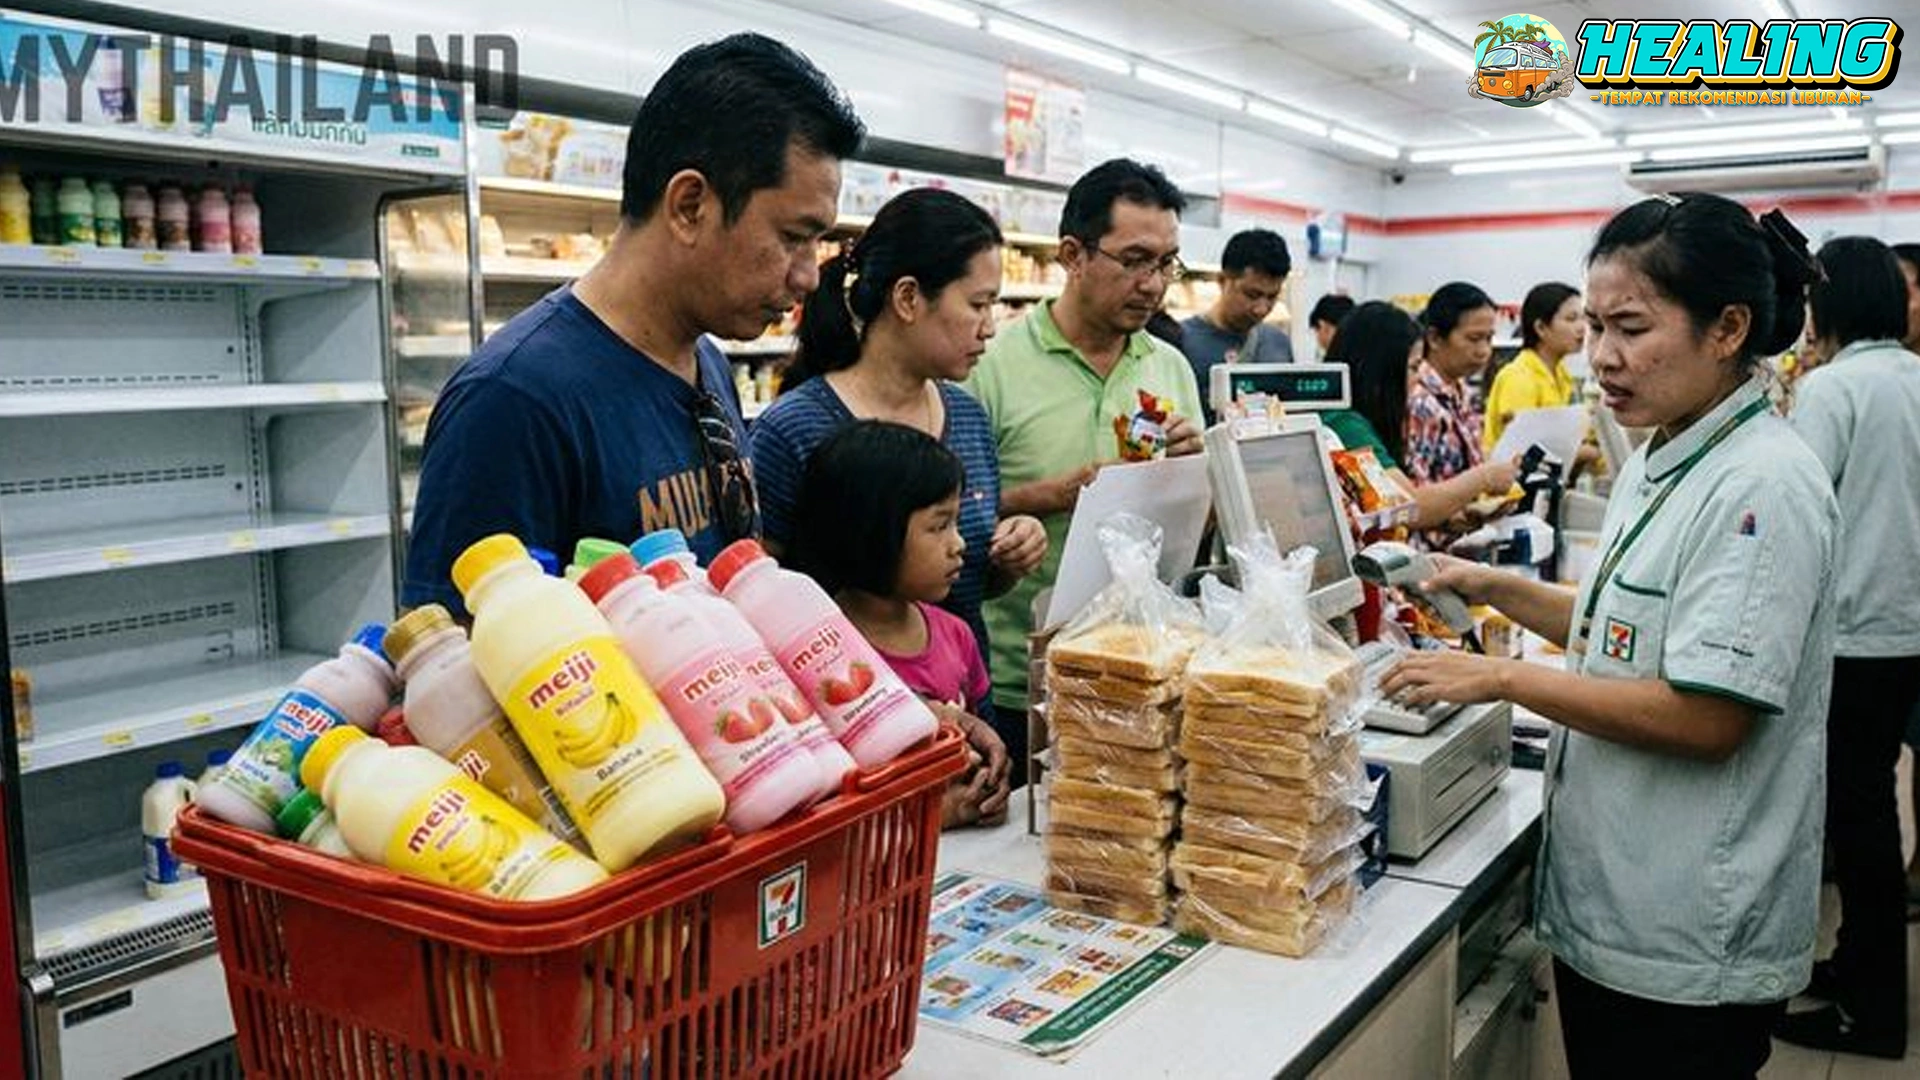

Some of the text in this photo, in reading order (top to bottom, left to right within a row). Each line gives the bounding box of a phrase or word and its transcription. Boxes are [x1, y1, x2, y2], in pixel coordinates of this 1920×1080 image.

[792, 625, 842, 671] meiji
[529, 651, 597, 708] meiji
[683, 655, 741, 700] meiji
[596, 748, 645, 780] Banana
[408, 789, 466, 854] meiji
